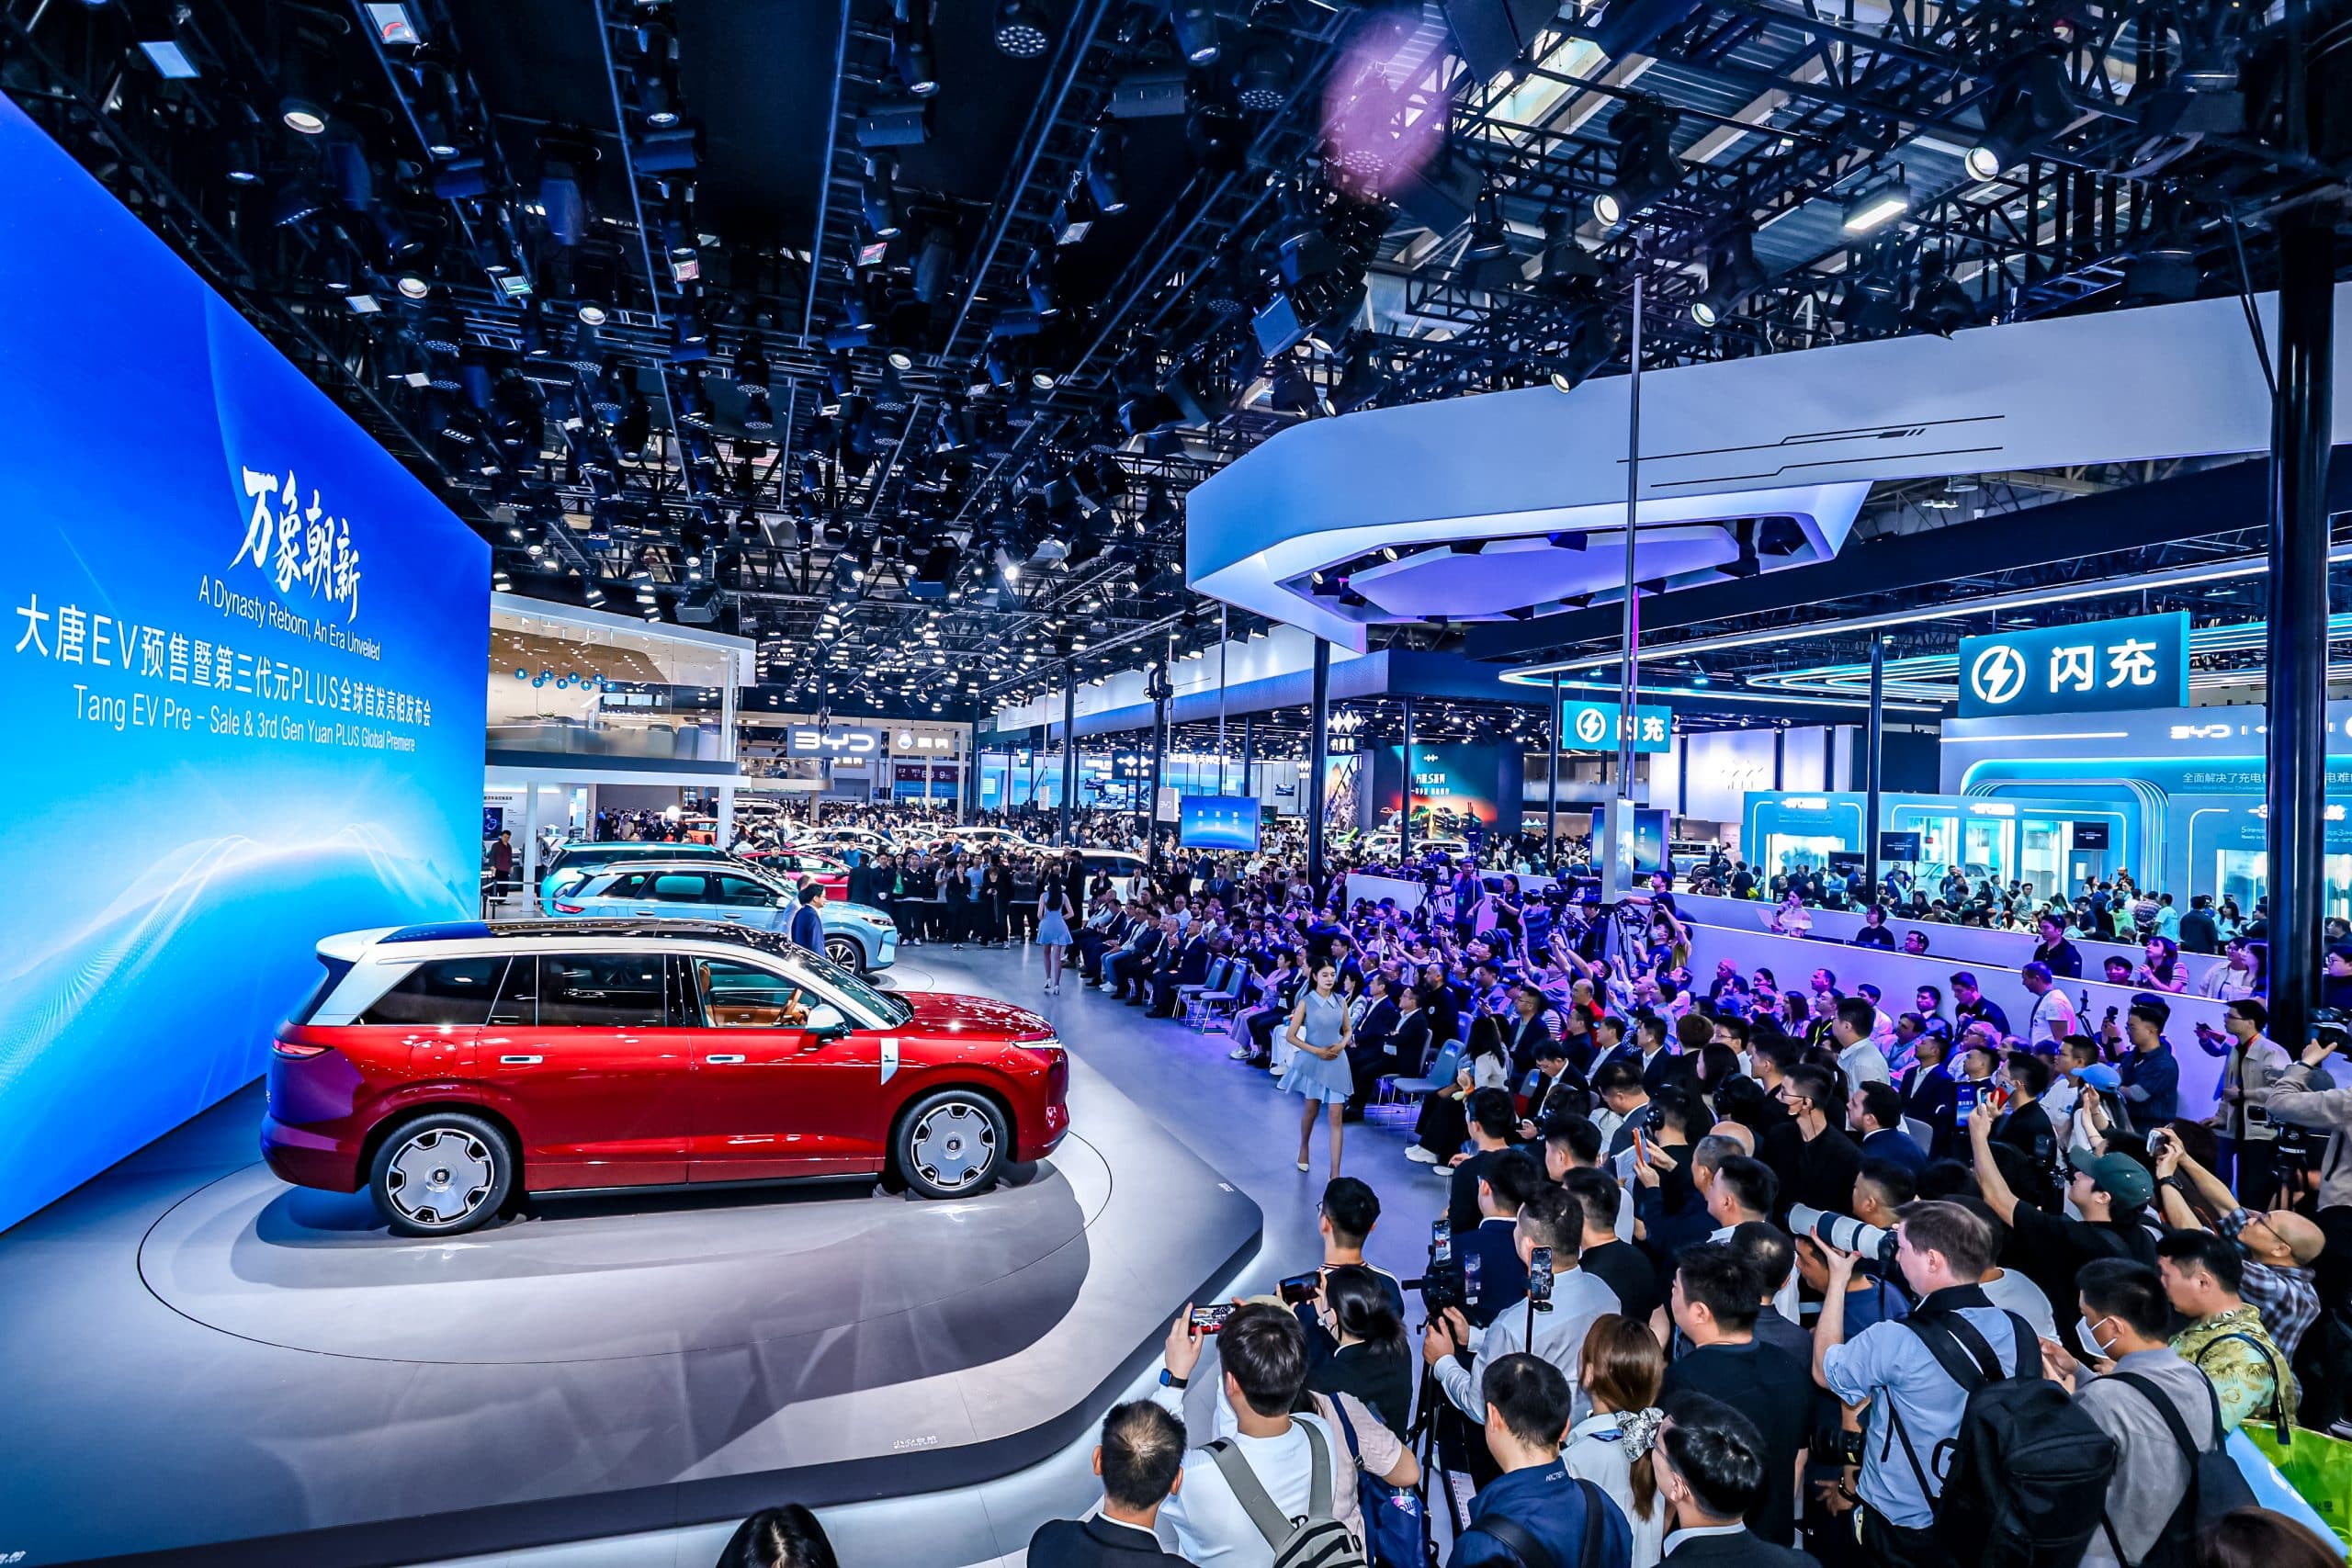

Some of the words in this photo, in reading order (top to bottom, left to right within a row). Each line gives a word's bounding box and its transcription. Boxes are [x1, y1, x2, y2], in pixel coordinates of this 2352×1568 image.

[228, 465, 361, 625] 万象朝新
[198, 574, 210, 604] A
[214, 580, 266, 629] Dynasty
[269, 601, 311, 643] Reborn,
[314, 618, 328, 642] An
[330, 624, 345, 649] Era
[347, 630, 381, 660] Unveiled
[2050, 638, 2157, 693] 闪充
[74, 683, 126, 731] Tang
[132, 693, 159, 727] EV
[164, 697, 191, 730] Pre
[210, 705, 240, 736] Sale
[243, 710, 254, 738] &
[257, 712, 277, 739] 3rd
[281, 715, 304, 740] Gen
[307, 719, 334, 744] Yuan
[335, 722, 359, 747] PLUS
[361, 727, 384, 750] Global
[386, 730, 415, 751] Premiere
[795, 731, 875, 752] BYD
[1617, 715, 1665, 741] 闪充
[2171, 724, 2231, 739] BYD
